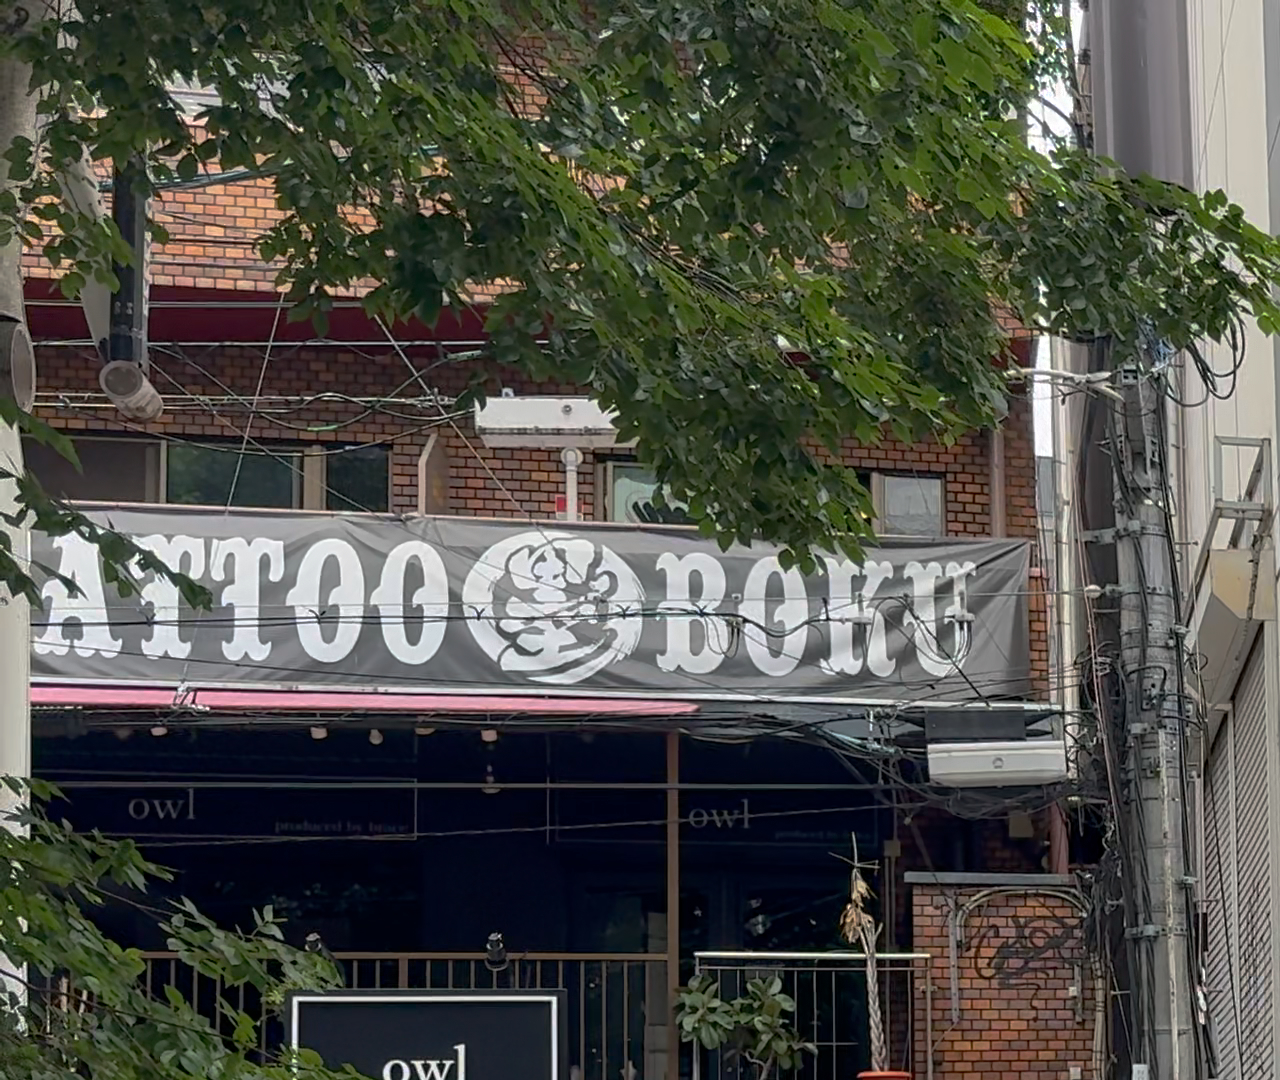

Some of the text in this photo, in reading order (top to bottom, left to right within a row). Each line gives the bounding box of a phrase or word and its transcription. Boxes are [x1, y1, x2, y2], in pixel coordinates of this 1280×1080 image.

[34, 532, 978, 678] ATTOO BOKU
[128, 788, 196, 820] owl
[689, 798, 750, 829] owl
